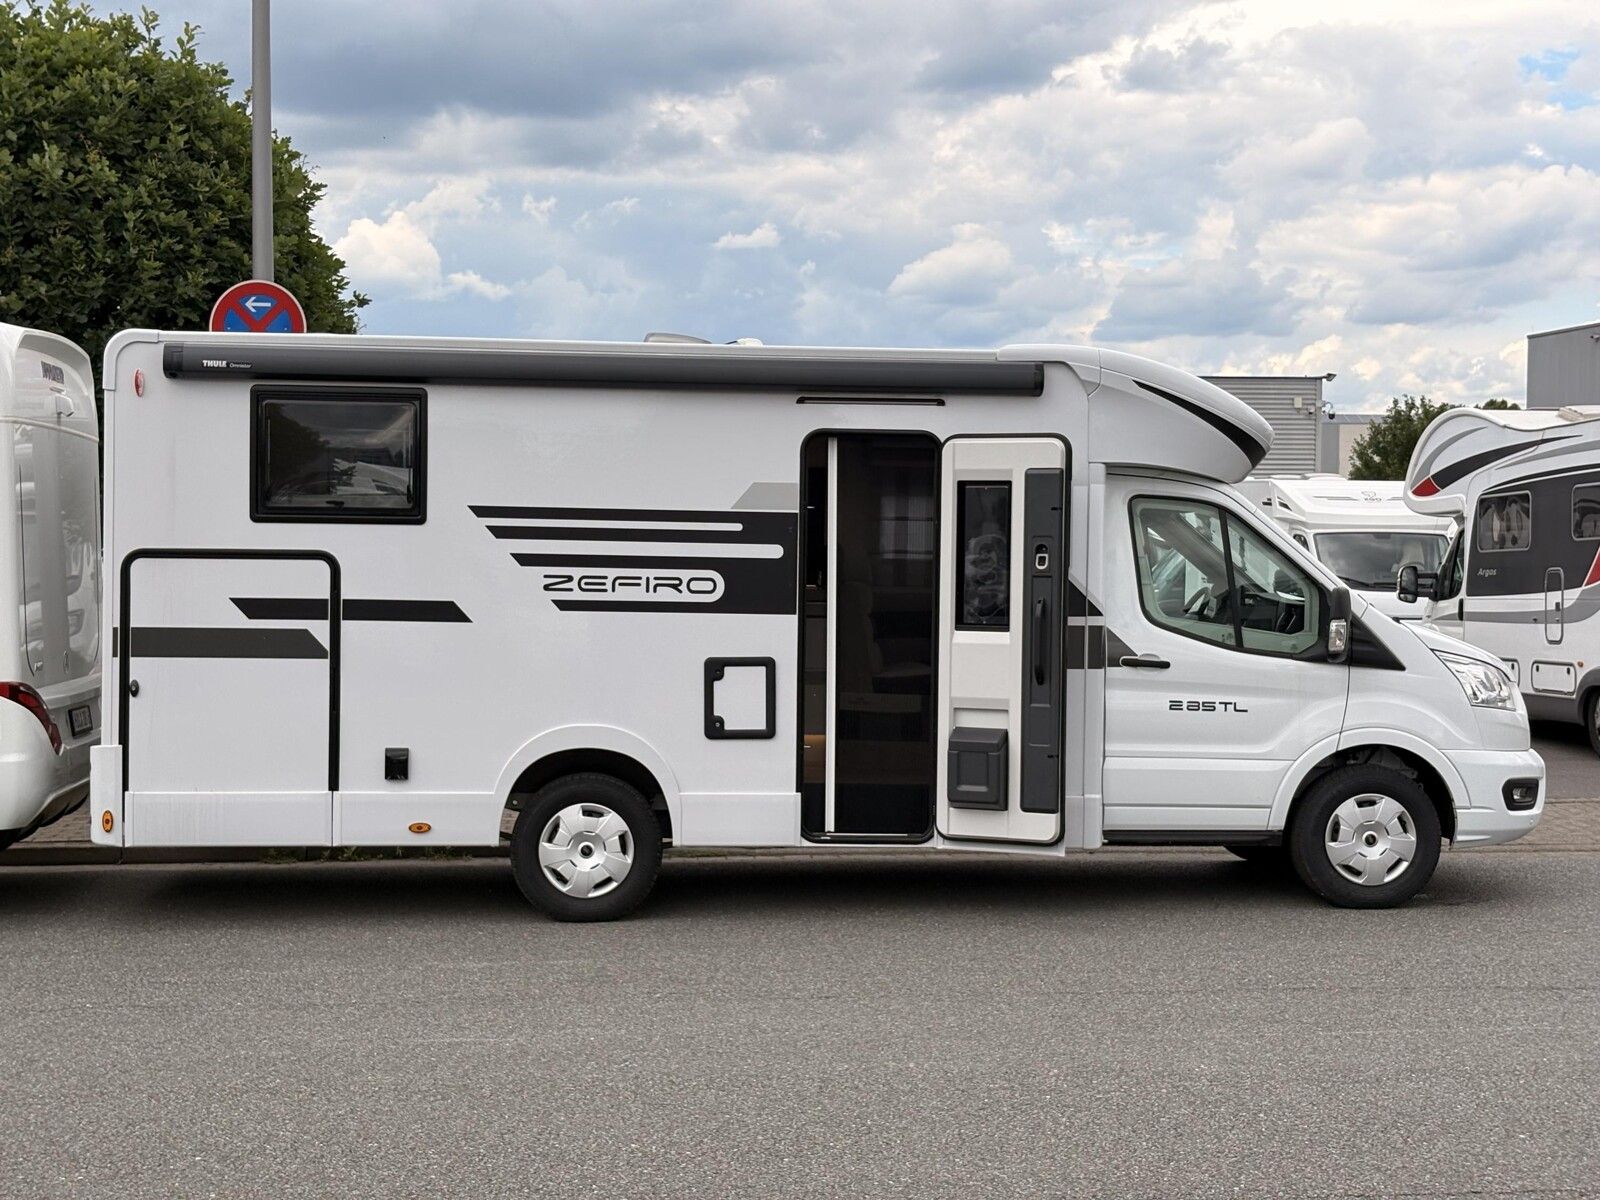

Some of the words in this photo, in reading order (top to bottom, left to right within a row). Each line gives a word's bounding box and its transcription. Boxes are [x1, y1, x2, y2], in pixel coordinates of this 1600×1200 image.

[202, 360, 227, 368] THULE
[543, 574, 717, 594] ZEFIRO
[1169, 700, 1248, 713] 285TL
